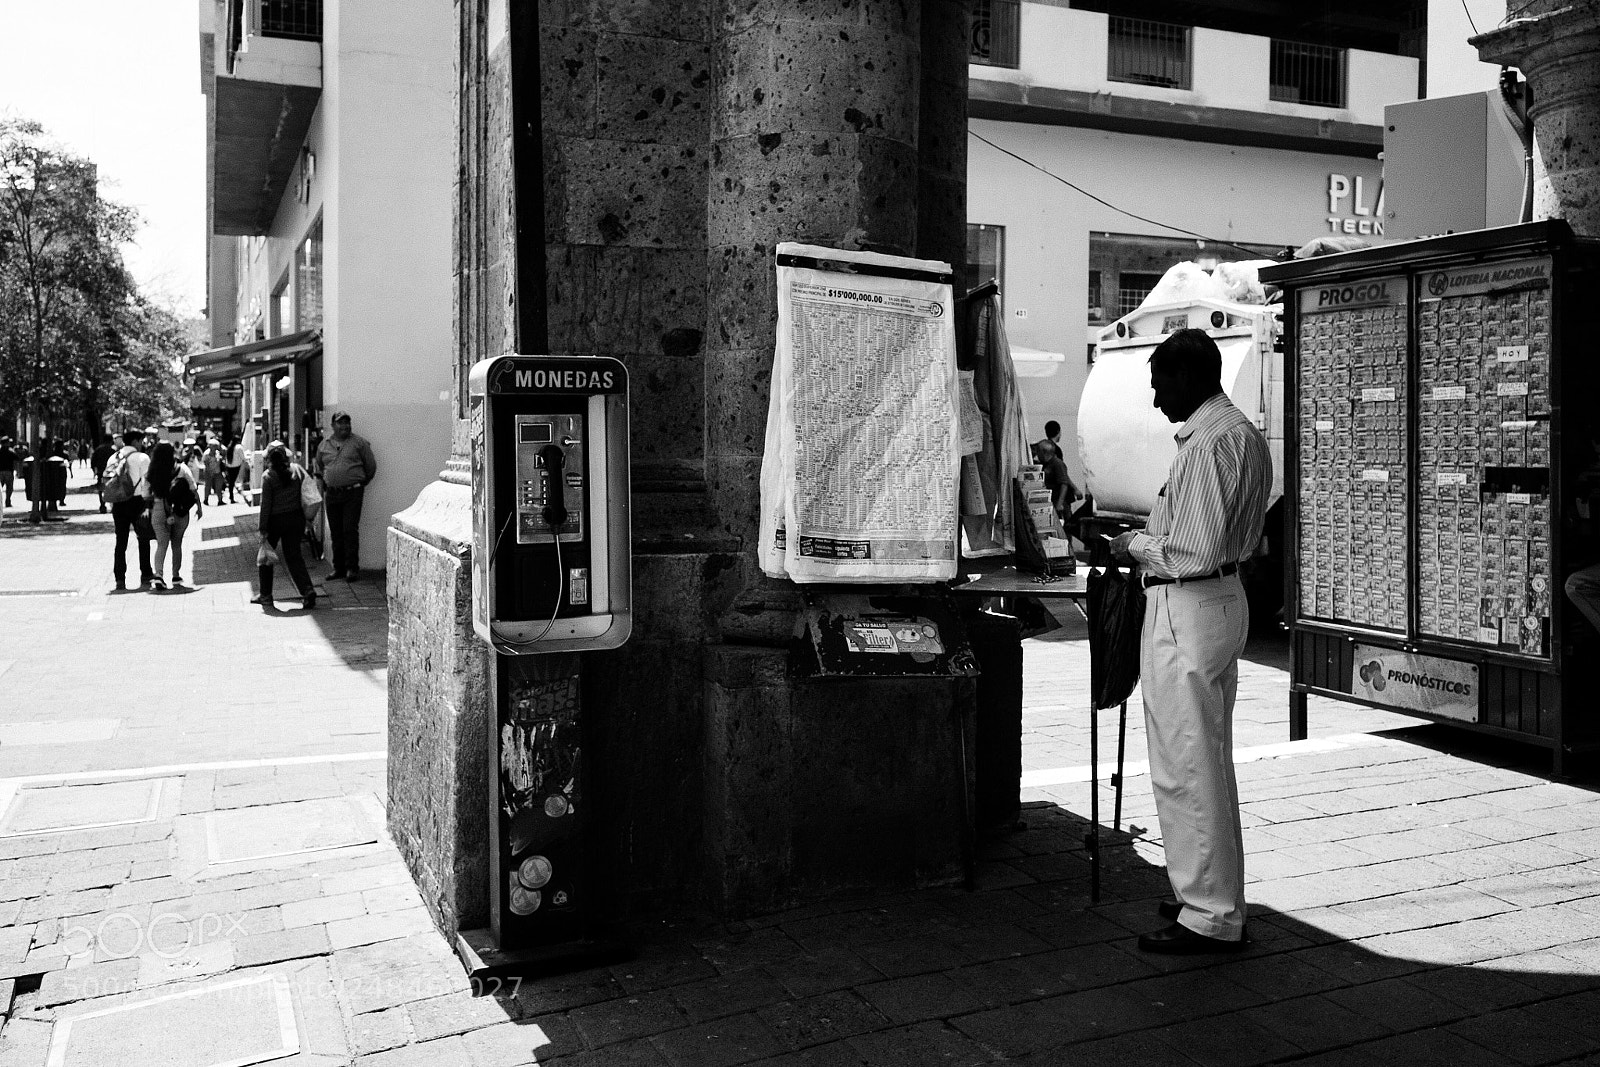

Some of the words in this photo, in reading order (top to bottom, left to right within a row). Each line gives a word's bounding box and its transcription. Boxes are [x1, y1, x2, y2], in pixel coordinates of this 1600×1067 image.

[1449, 272, 1490, 288] LOTERIA
[1491, 264, 1545, 283] NACIONAL
[828, 289, 883, 303] $15'000,000.00
[1318, 281, 1391, 307] PROGOL
[1502, 349, 1521, 358] HOY
[515, 370, 614, 388] MONEDAS
[1387, 669, 1472, 696] PRONÓSTICOS
